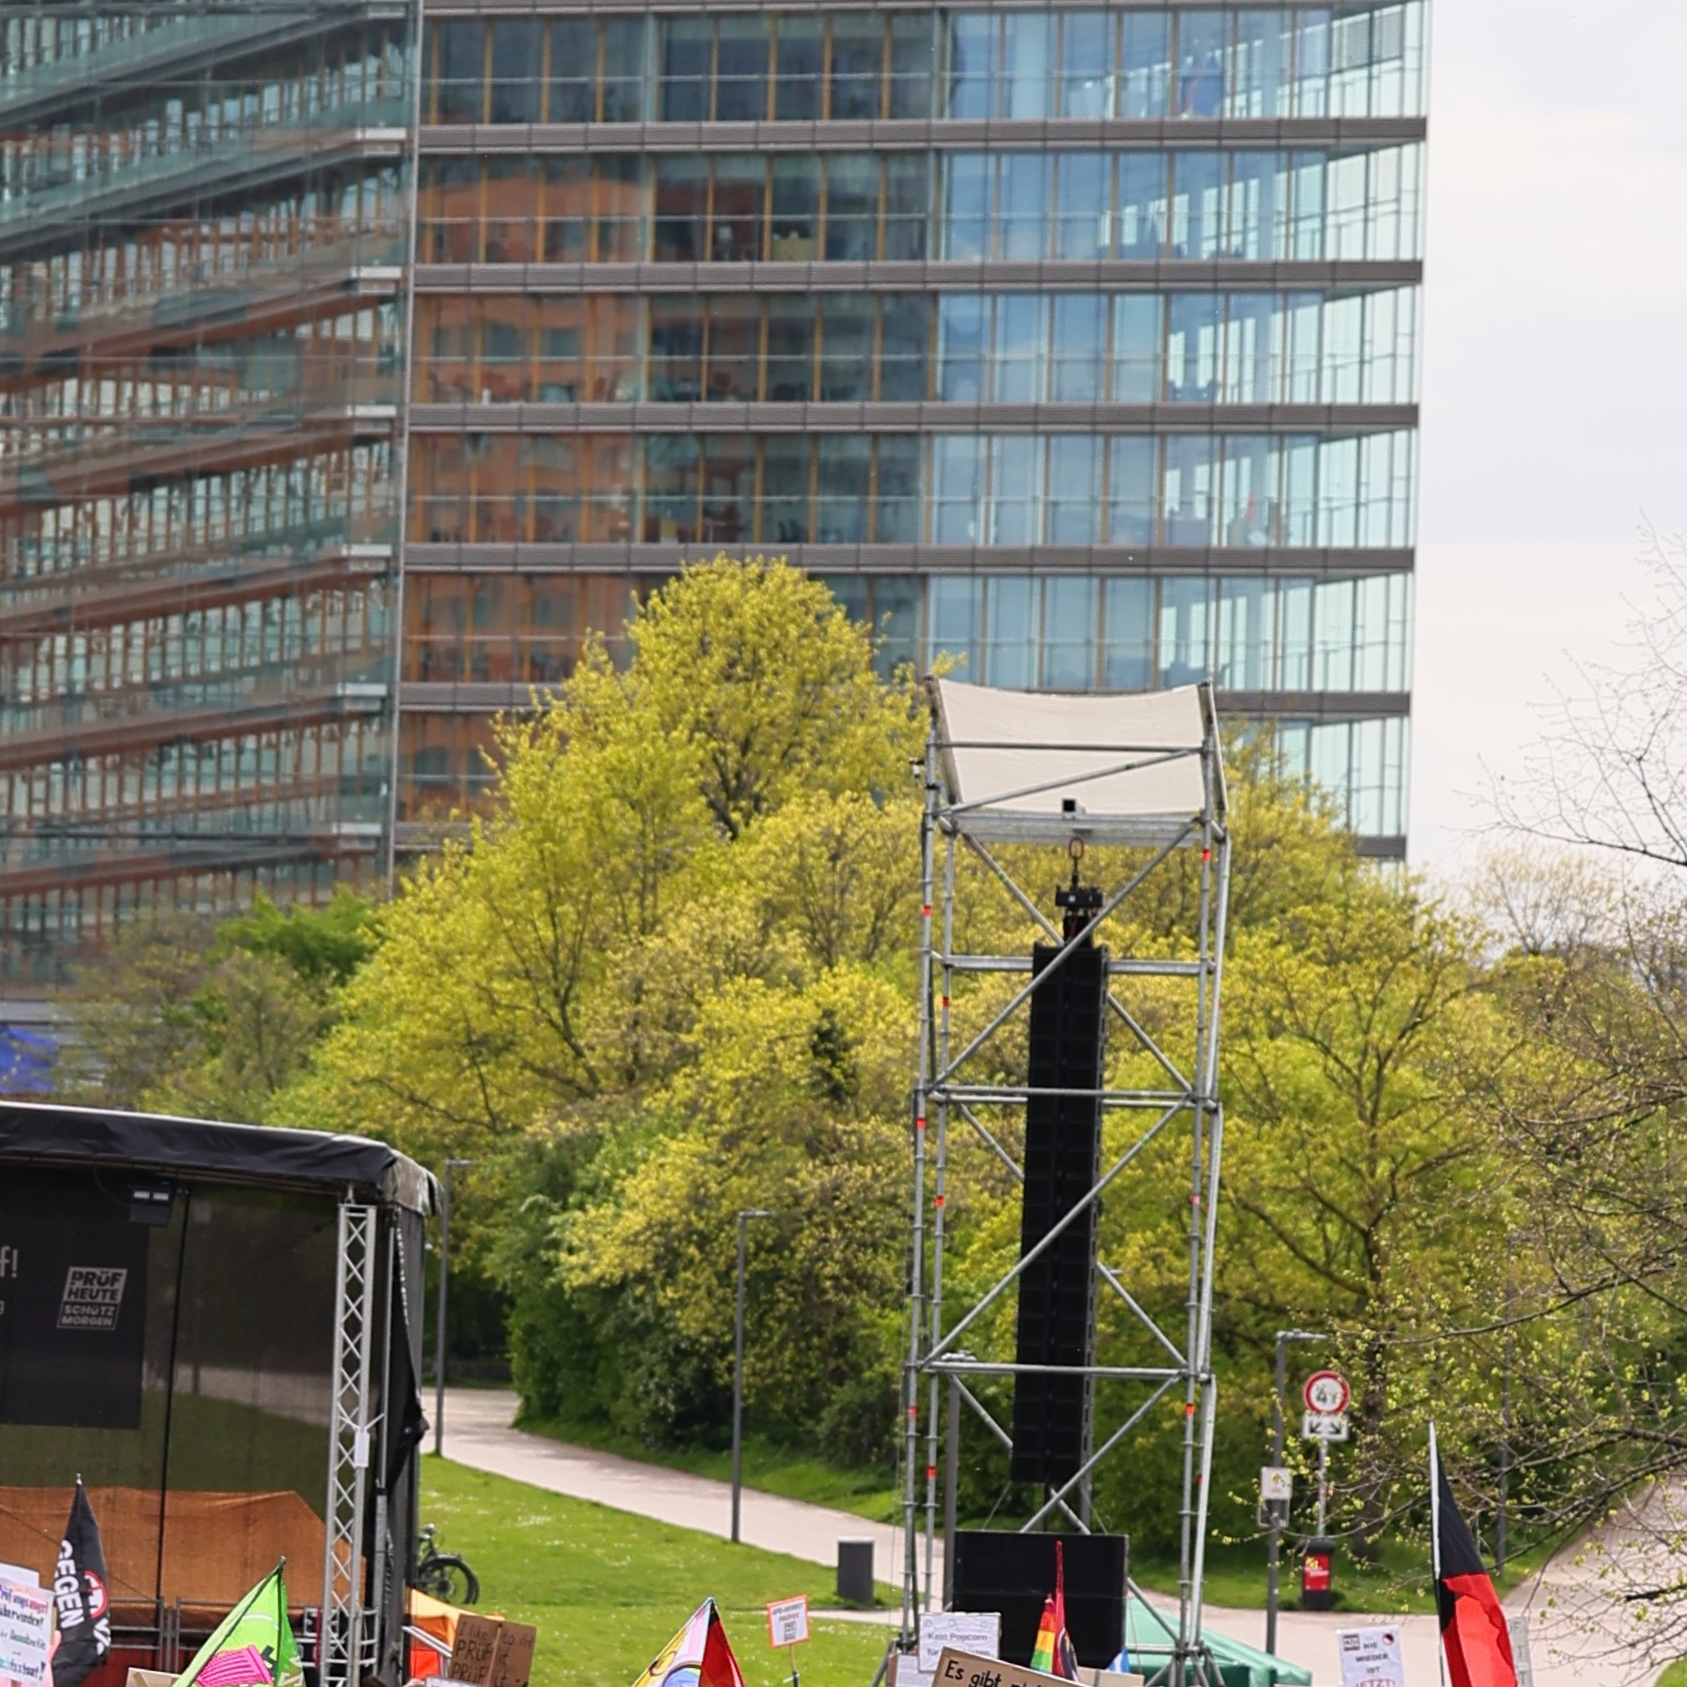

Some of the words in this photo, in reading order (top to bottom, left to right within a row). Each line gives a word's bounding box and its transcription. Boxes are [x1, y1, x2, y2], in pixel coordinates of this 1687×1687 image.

[69, 1270, 124, 1288] PRÜF
[66, 1287, 120, 1302] HEUTE
[64, 1304, 116, 1316] SCHÜTZ
[61, 1315, 113, 1327] MORGEN
[927, 1631, 948, 1642] Kein
[949, 1632, 988, 1643] Popcorn
[1355, 1653, 1390, 1664] WIEDER
[944, 1660, 965, 1681] Es
